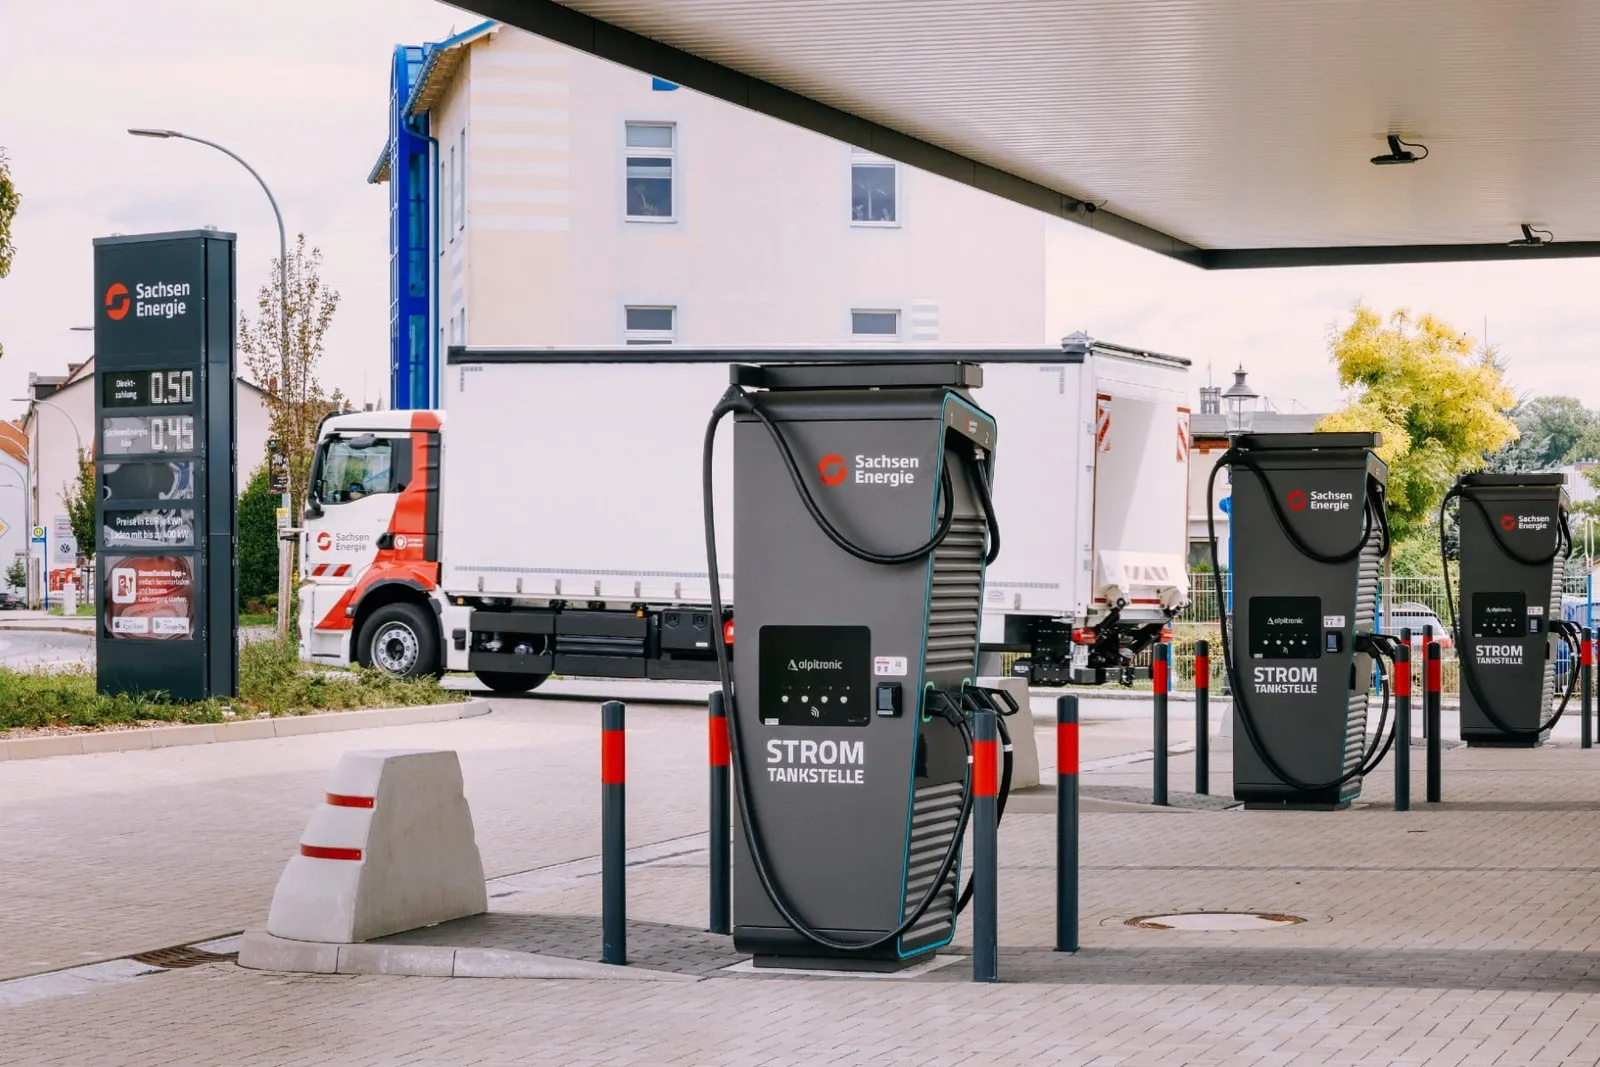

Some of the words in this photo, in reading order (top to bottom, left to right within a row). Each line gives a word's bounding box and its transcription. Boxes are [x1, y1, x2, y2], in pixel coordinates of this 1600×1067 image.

[136, 281, 190, 299] Sachsen
[136, 299, 187, 318] Energie
[151, 371, 194, 404] 0.50
[115, 391, 138, 400] zahlung
[151, 417, 194, 450] 0.45
[855, 455, 919, 468] Sachsen
[855, 470, 915, 487] Energie
[1310, 491, 1353, 500] Sachsen
[1310, 501, 1350, 511] Energie
[116, 517, 136, 526] Preise
[1518, 515, 1550, 523] Sachsen
[1518, 522, 1548, 531] Energie
[143, 530, 154, 539] bis
[335, 532, 370, 541] Sachsen
[335, 542, 367, 552] Energie
[1476, 645, 1523, 657] STROM
[798, 659, 843, 671] alpitronic
[1476, 657, 1523, 665] TANKSTELLE
[1253, 666, 1318, 683] STROM
[1254, 684, 1318, 694] TANKSTELLE
[766, 739, 865, 766] STROM
[767, 767, 865, 784] TANKSTELLE
